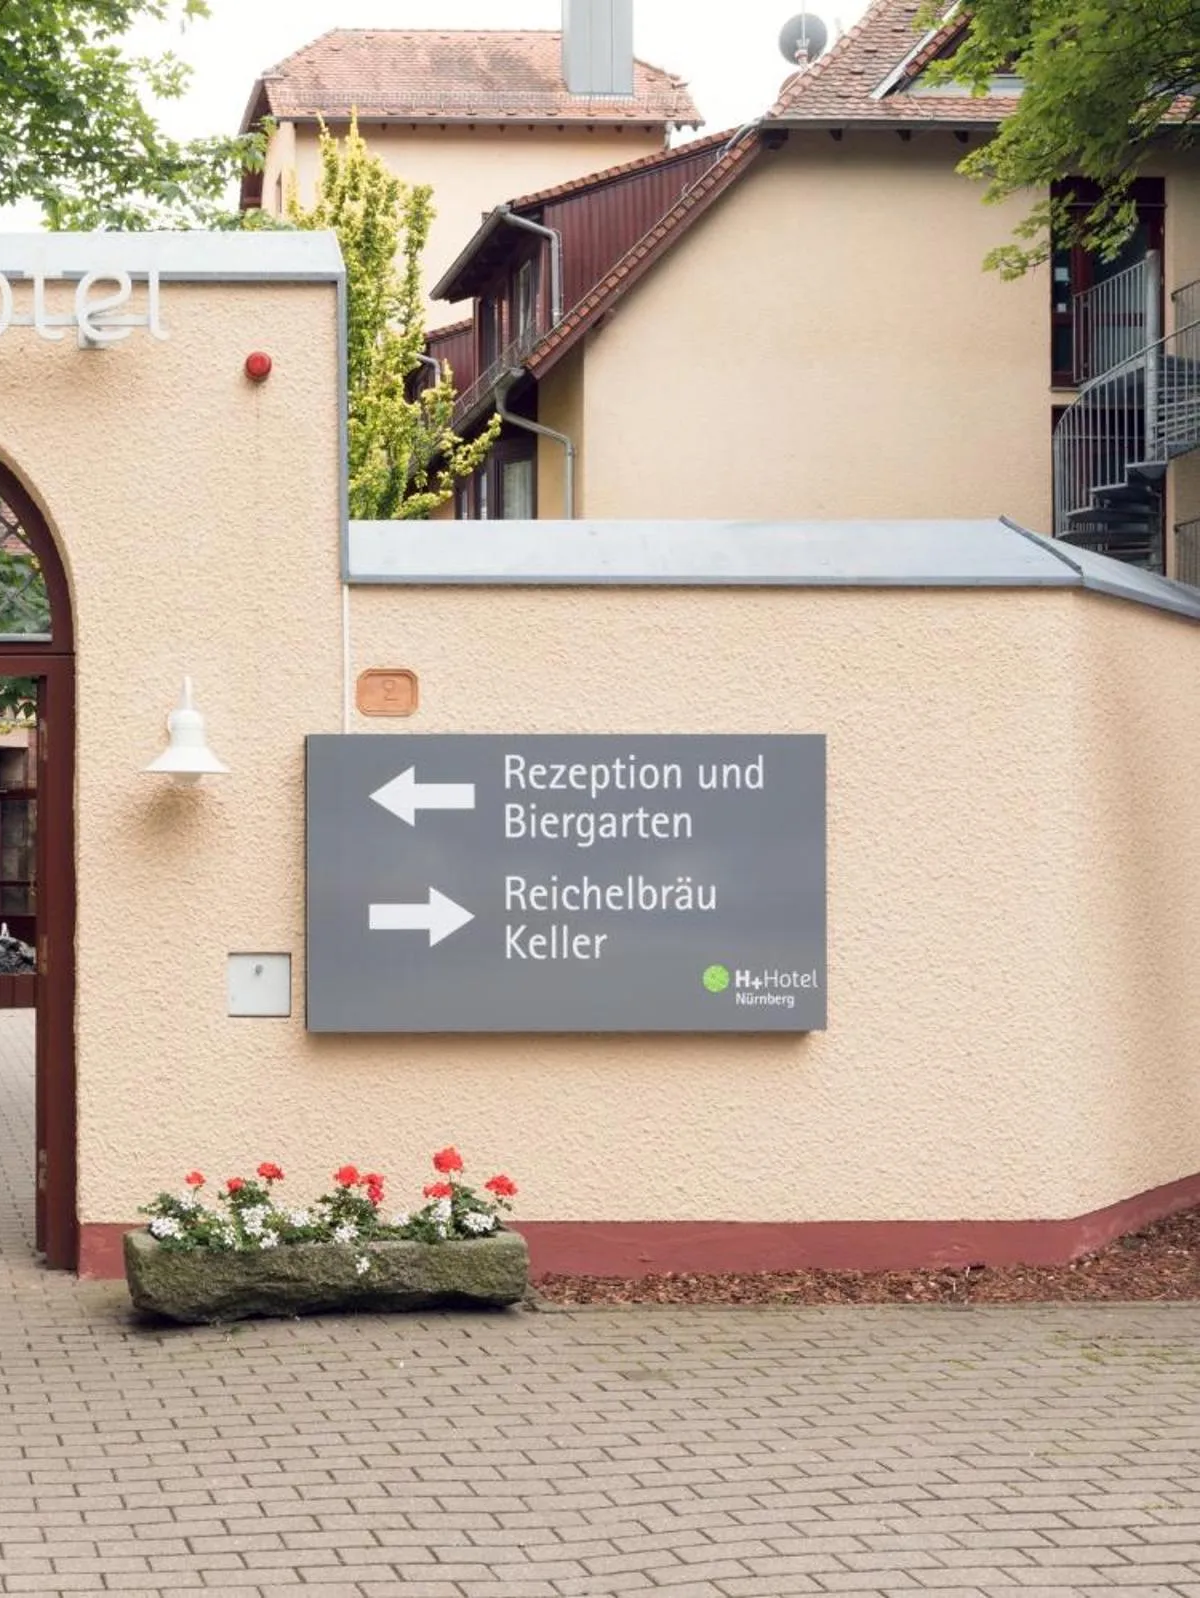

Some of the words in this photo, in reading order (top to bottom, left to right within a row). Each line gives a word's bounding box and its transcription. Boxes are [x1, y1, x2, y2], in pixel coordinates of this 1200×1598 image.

[504, 754, 682, 799] Rezeption
[698, 754, 764, 790] und
[504, 803, 692, 848] Biergarten
[504, 875, 717, 911] Reichelbräu
[504, 924, 608, 960] Keller
[735, 968, 819, 990] H+Hotel
[735, 991, 796, 1009] Nürnberg
